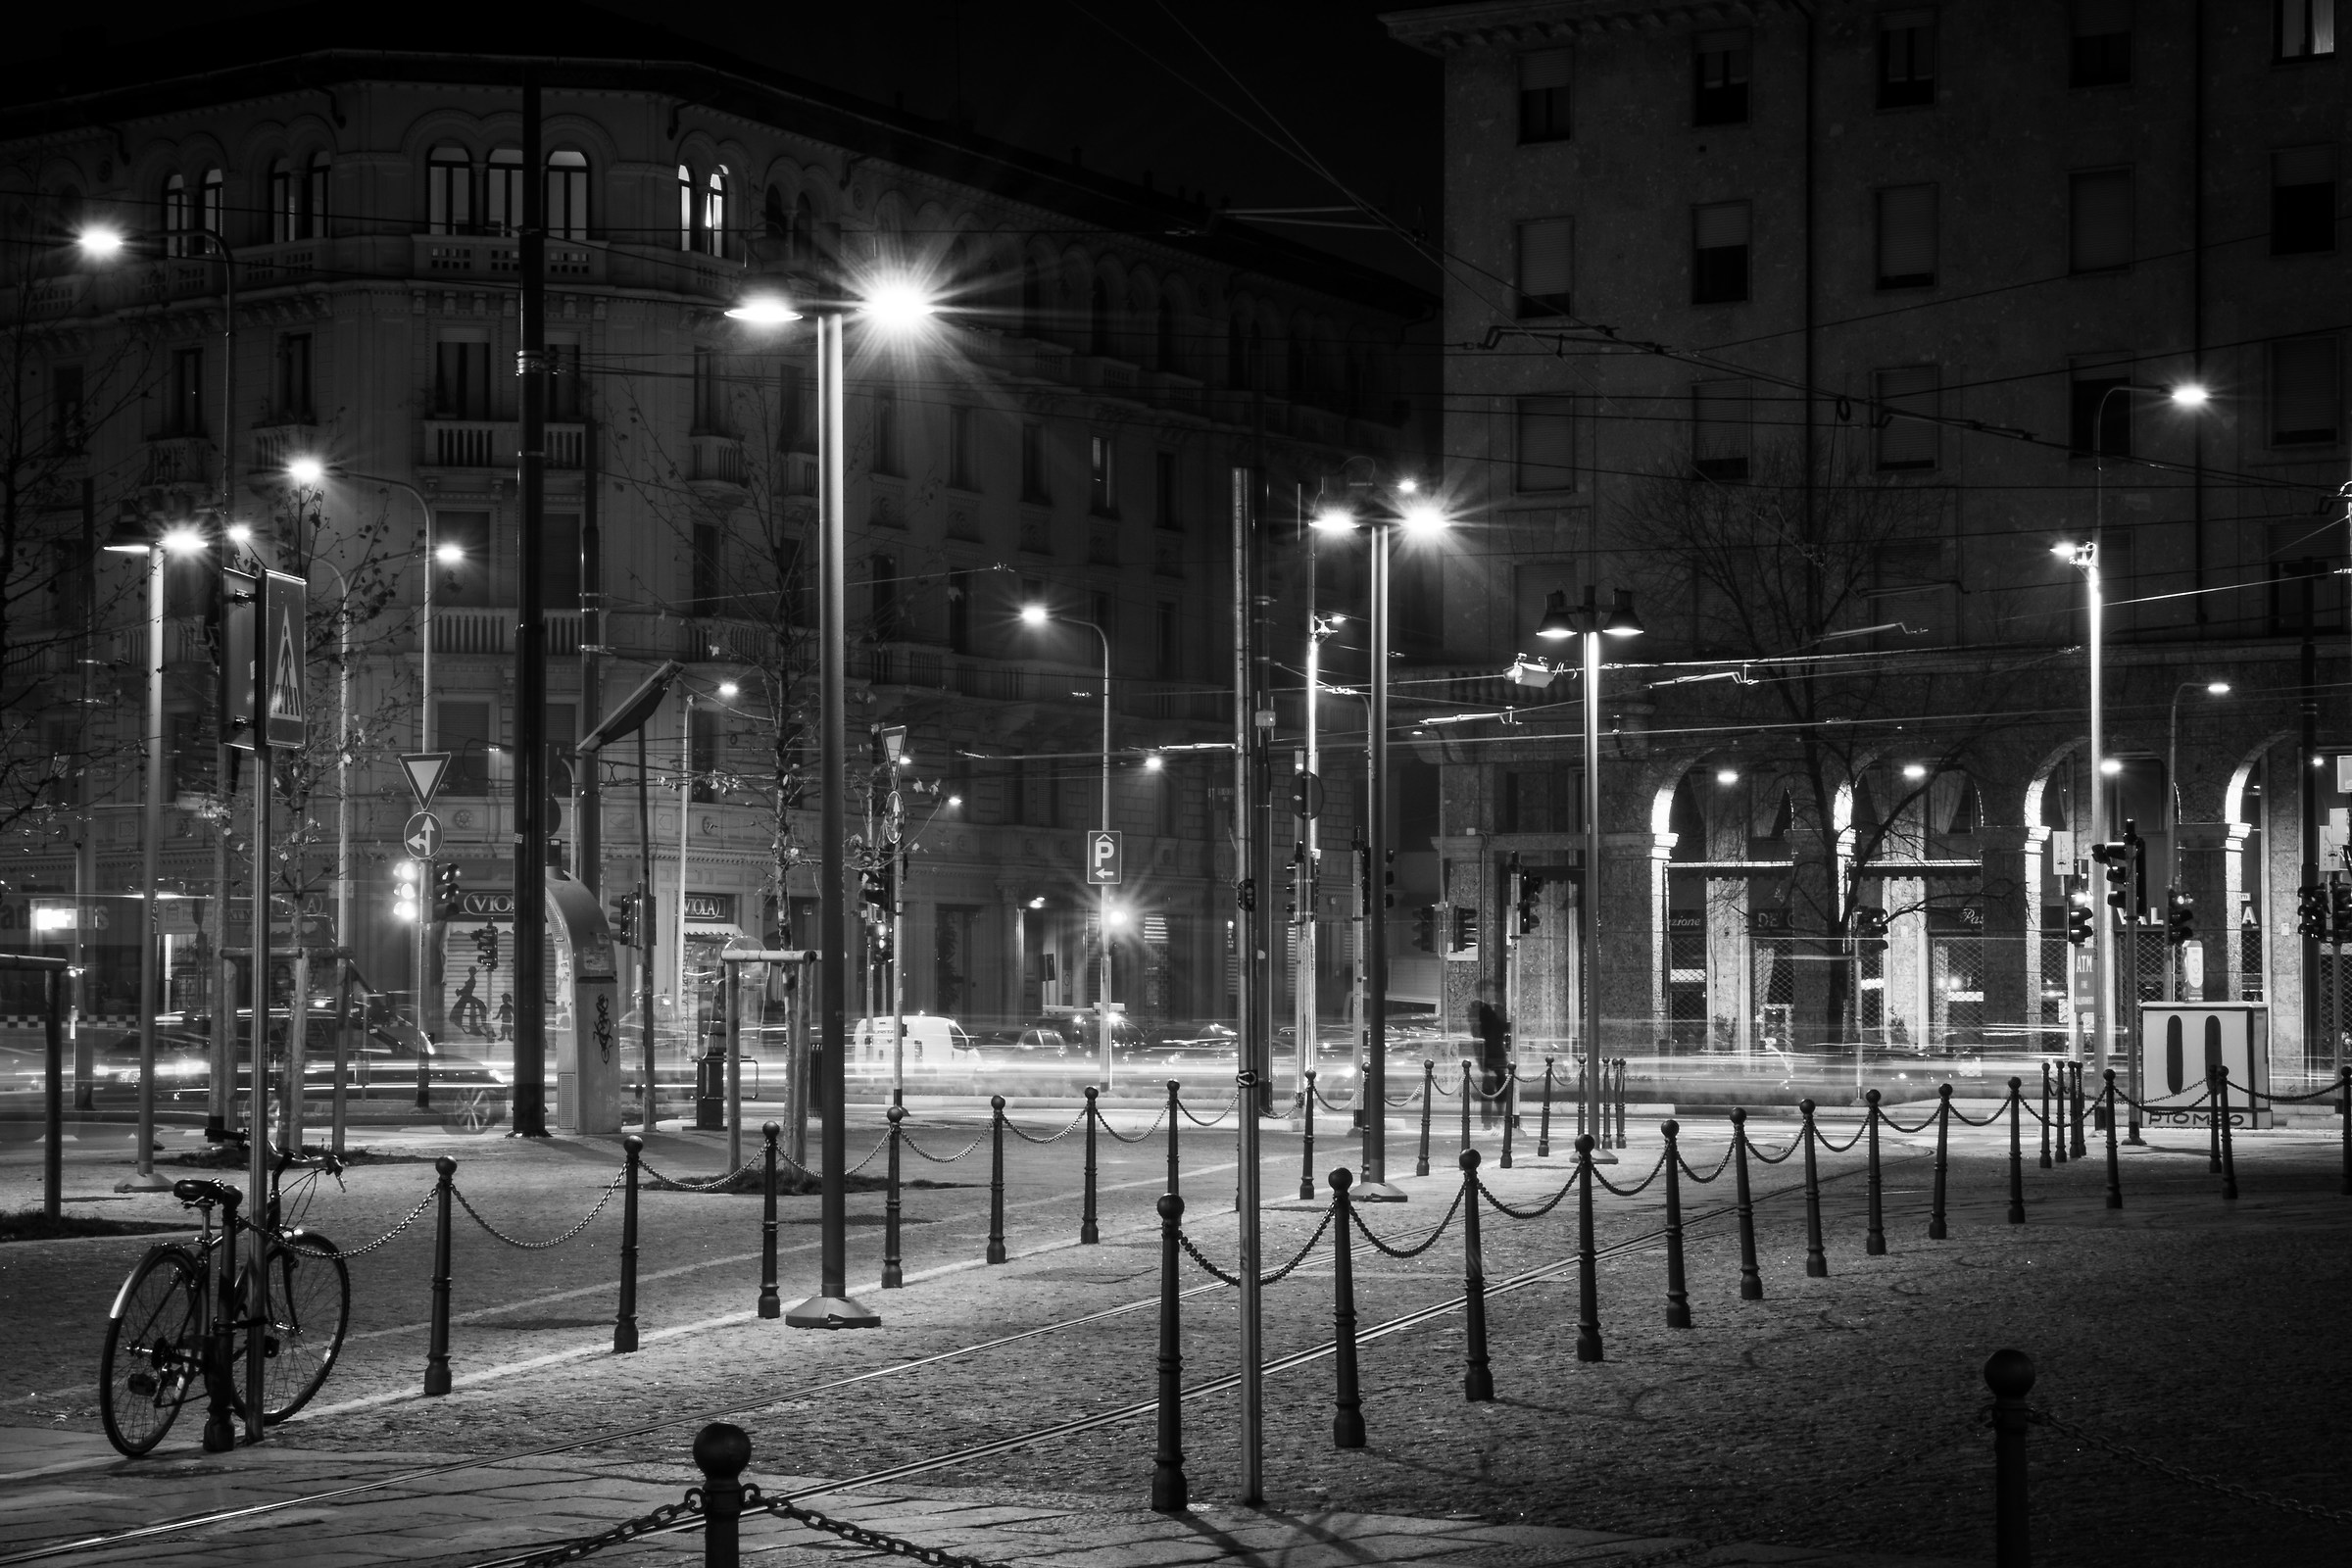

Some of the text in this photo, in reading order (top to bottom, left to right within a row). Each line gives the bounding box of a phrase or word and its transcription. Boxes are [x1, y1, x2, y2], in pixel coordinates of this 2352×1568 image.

[1095, 842, 1114, 867] P
[2076, 955, 2093, 973] ATM
[2149, 1109, 2243, 1127] PIOMO
